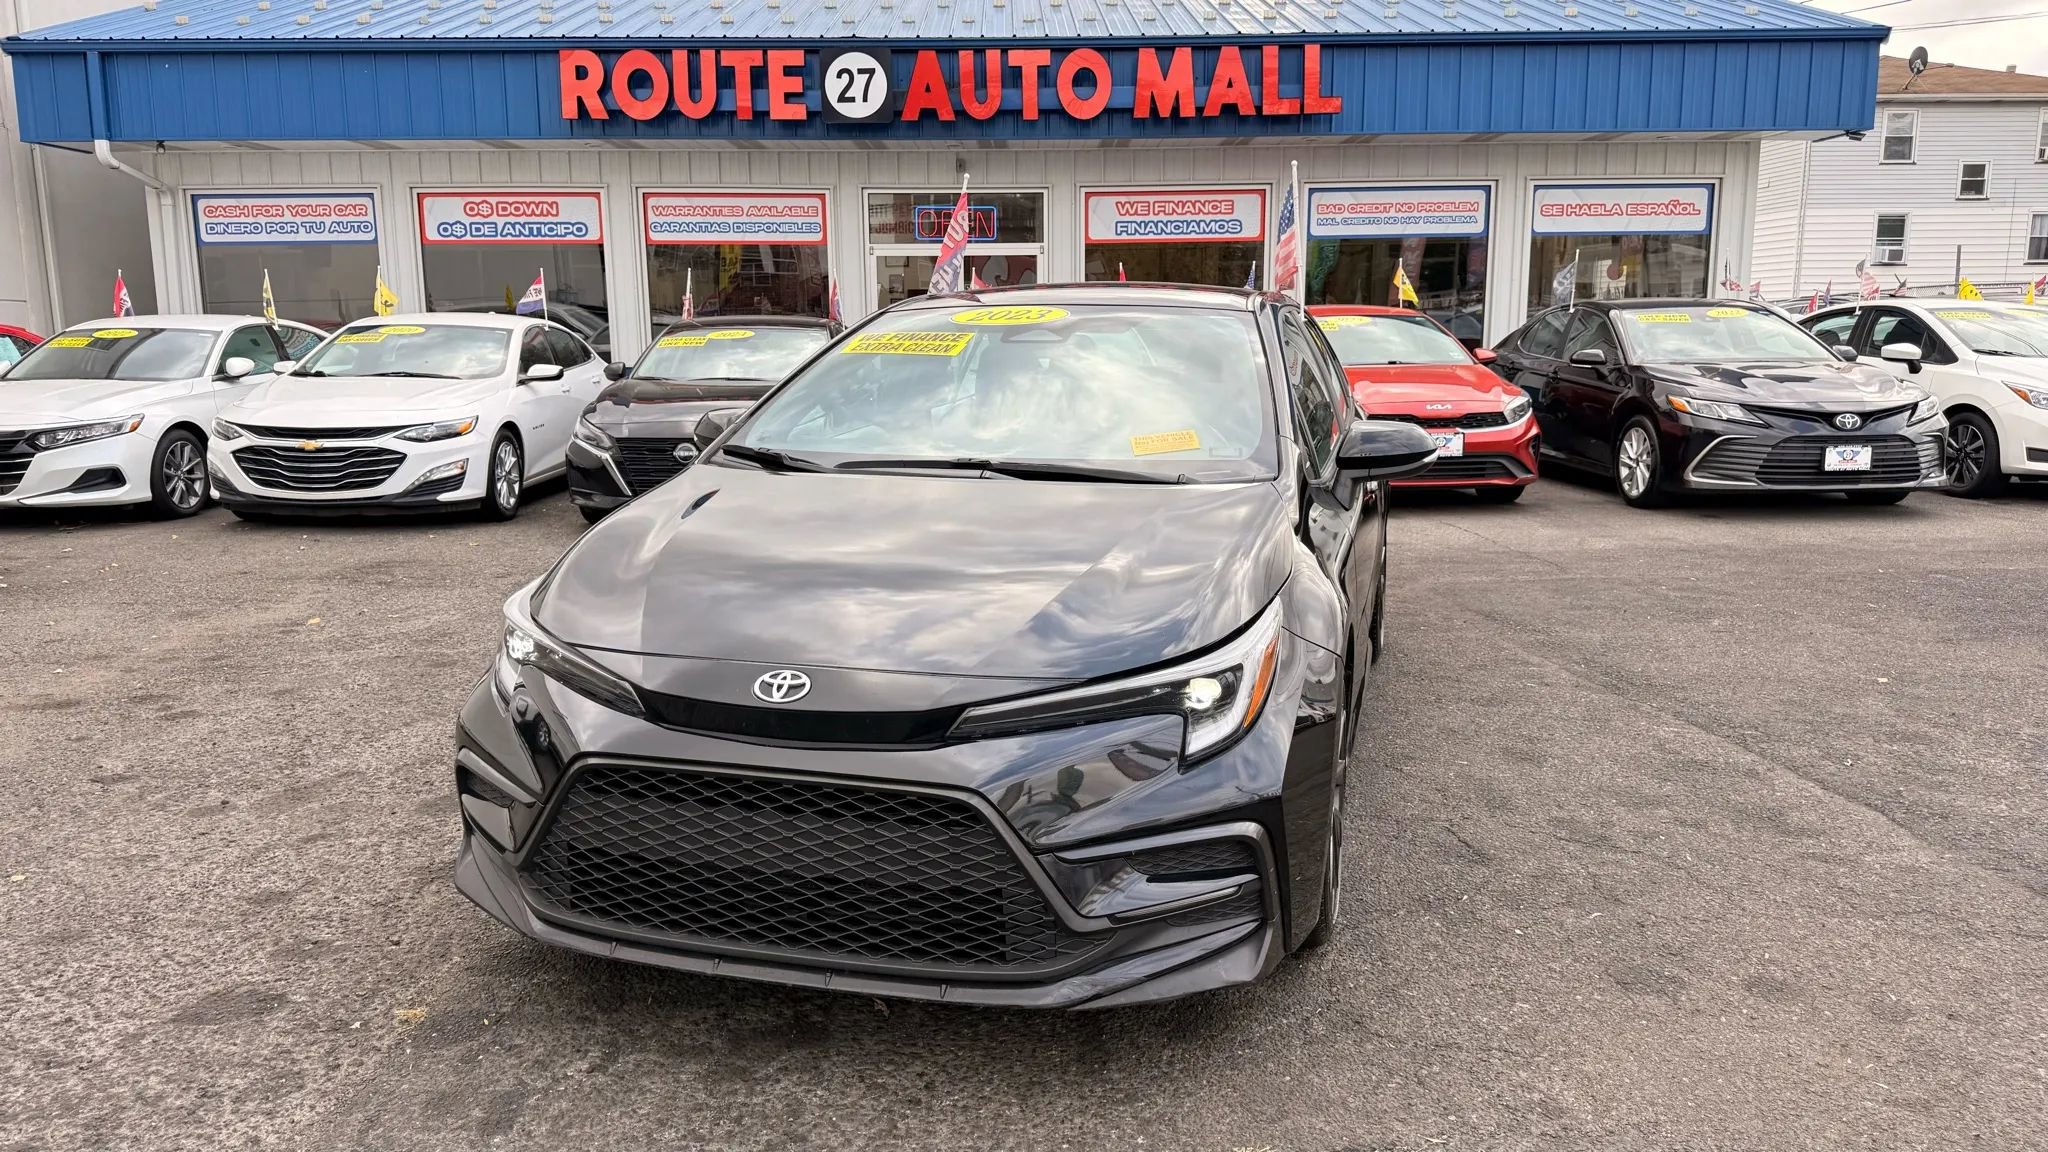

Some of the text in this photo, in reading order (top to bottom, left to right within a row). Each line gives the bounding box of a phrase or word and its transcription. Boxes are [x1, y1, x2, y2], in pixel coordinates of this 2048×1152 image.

[559, 43, 1342, 121] ROUTE 27 AUTO MALL
[204, 204, 368, 218] CASH FOR YOUR CAR
[496, 201, 559, 217] DOWN
[652, 205, 818, 217] WARRANTIES AVAILABLE
[1116, 200, 1234, 216] WE FINANCE
[1317, 202, 1478, 214] BAD CREDIT NO PROBLEM
[1540, 200, 1701, 217] SE HABLA ESPAÑOL
[206, 220, 373, 235] DINERO POR TU AUTO
[650, 221, 821, 234] GARANTIAS DISPONIBLES
[1115, 219, 1243, 236] FINANCIAMOS
[1317, 215, 1477, 226] MAL CREDITO NO HAY PROBLEMA
[469, 222, 498, 238] DE
[499, 221, 588, 238] ANTICIPO
[966, 308, 1051, 322] 2023
[859, 332, 969, 343] WE FINANCE
[849, 342, 956, 353] EXTRA CLEAN
